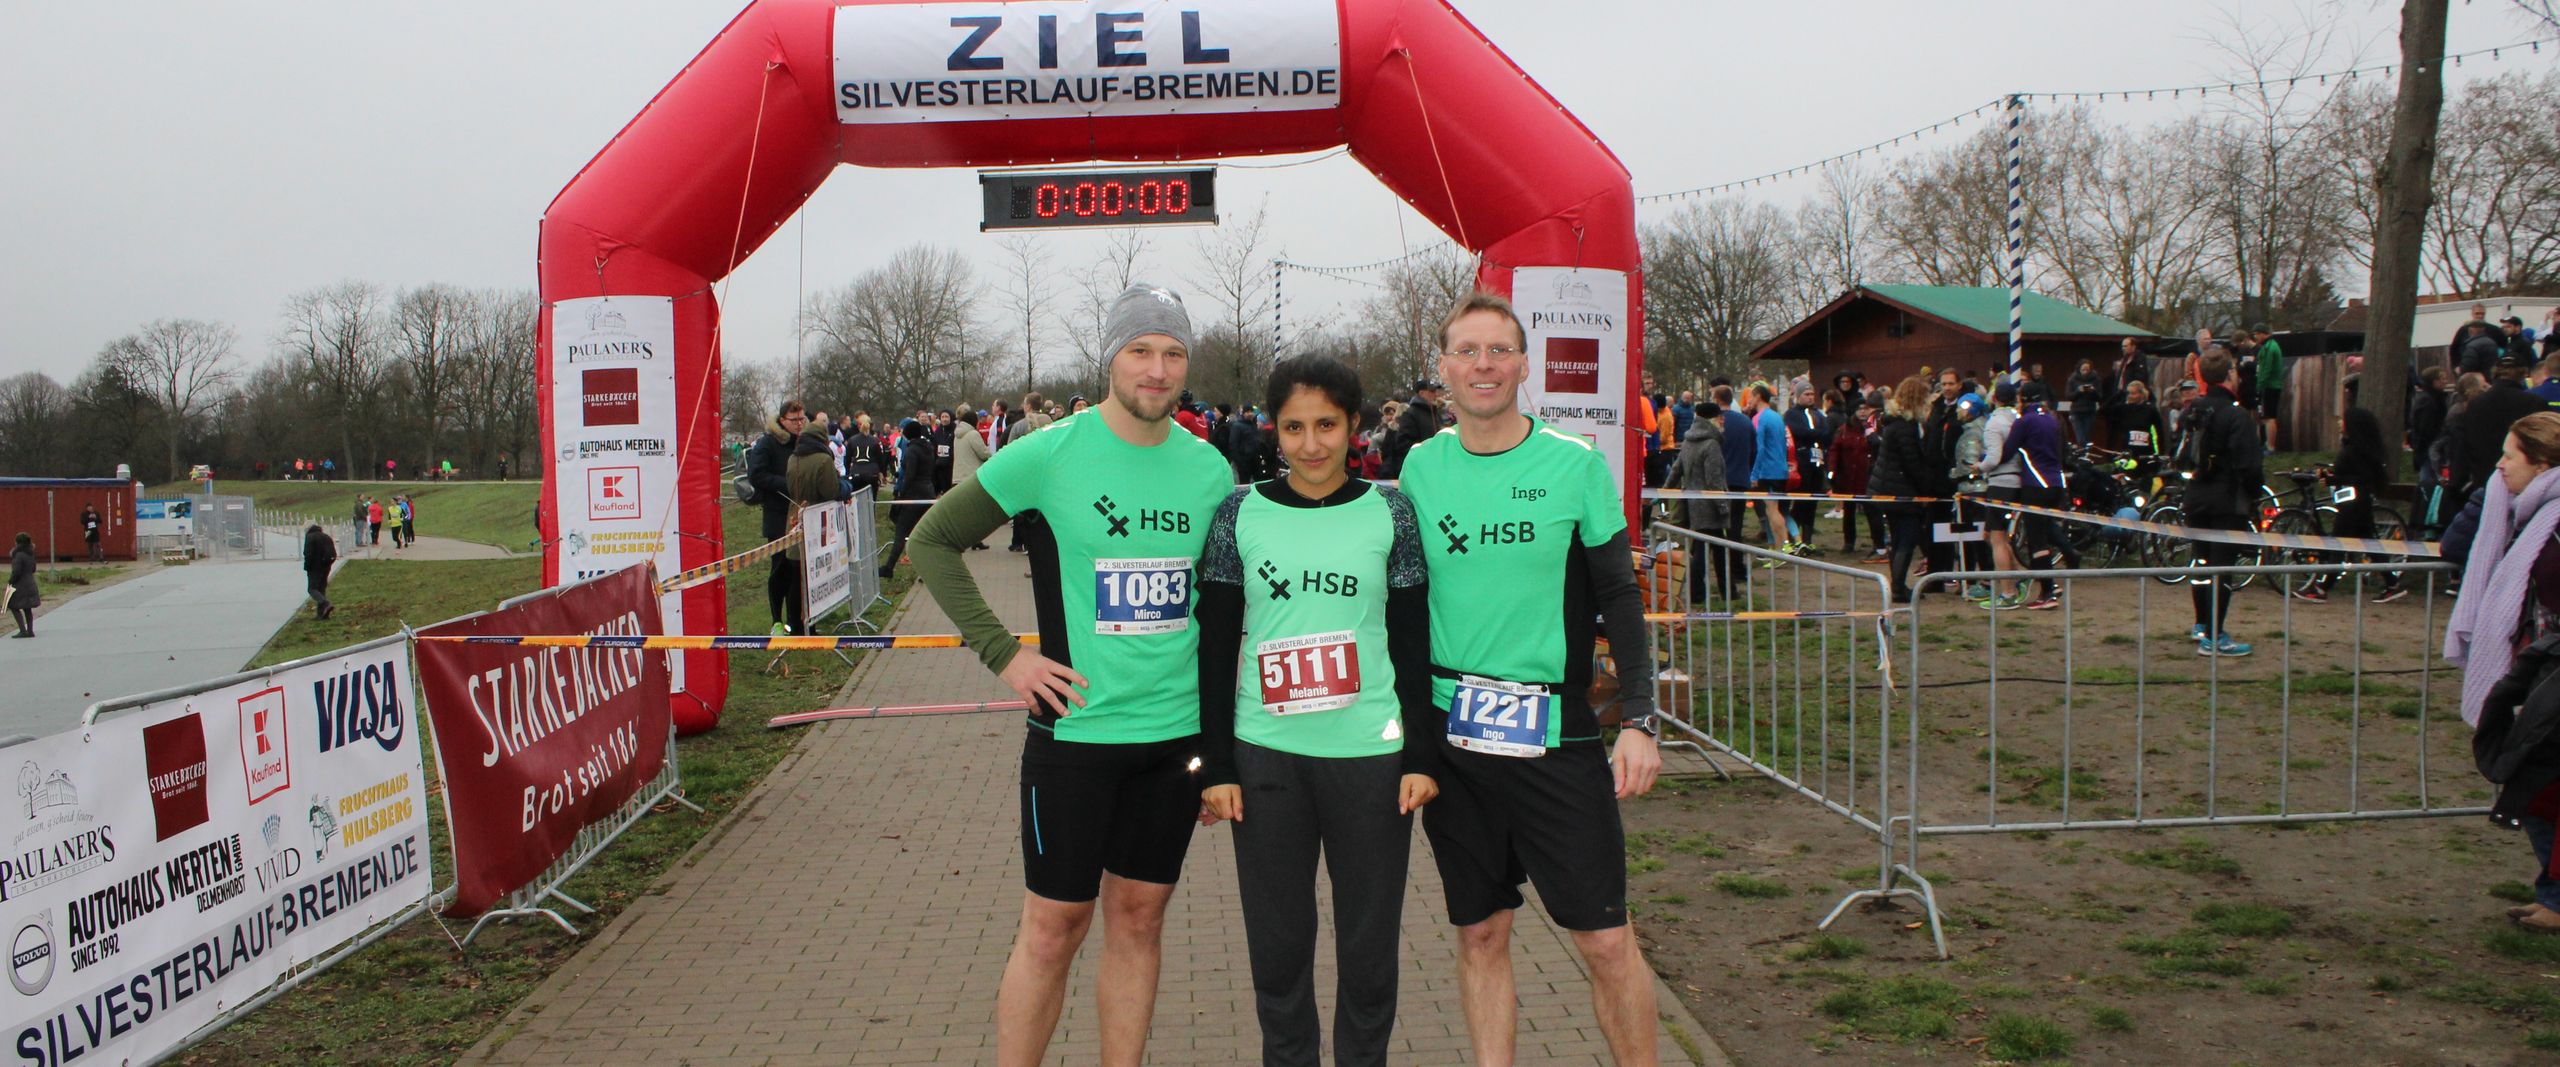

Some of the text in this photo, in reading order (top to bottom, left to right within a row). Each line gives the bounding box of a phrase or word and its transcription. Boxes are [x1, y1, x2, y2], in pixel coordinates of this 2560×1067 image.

[947, 11, 1230, 72] ZIEL
[841, 69, 1337, 110] SILVESTERLAUF-BREMEN.DE
[1037, 180, 1187, 217] 0:00:00
[1532, 311, 1613, 332] PAULANER'S
[569, 341, 653, 363] PAULANER'S
[1540, 406, 1583, 419] AUTOHAUS
[1585, 408, 1614, 420] MERTEN
[580, 440, 623, 453] AUTOHAUS
[625, 439, 659, 451] MERTEN
[594, 503, 635, 511] Kaufland
[1511, 487, 1547, 501] Ingo
[1140, 508, 1190, 534] HSB
[1480, 521, 1536, 545] HSB
[591, 543, 665, 555] HULSBERG
[1112, 561, 1163, 569] SILVESTERLAUF
[1104, 571, 1187, 607] 1083
[1302, 570, 1359, 597] HSB
[1134, 609, 1161, 620] Mirco
[1270, 638, 1318, 651] SILVESTERLAUF
[1320, 634, 1348, 644] BREMEN
[1263, 645, 1347, 689] 5111
[1289, 685, 1329, 699] Melanie
[314, 660, 404, 753] VILSA
[1457, 688, 1539, 730] 1221
[1482, 727, 1505, 741] Ingo
[251, 758, 282, 784] Kaufland
[339, 773, 409, 817] FRUCHTHAUS
[522, 769, 575, 833] Brot
[578, 744, 612, 796] seit
[342, 797, 412, 848] HULSBERG
[0, 825, 115, 902] PAULANER'S
[255, 848, 301, 893] VIVID
[68, 833, 244, 947] AUTOHAUS MERTEN GMBH
[197, 874, 246, 914] DELMENHORST
[15, 945, 49, 965] VOLVO
[16, 835, 419, 1067] SILVESTERLAUF-BREMEN.DE
[72, 933, 120, 973] SINCE 1992
